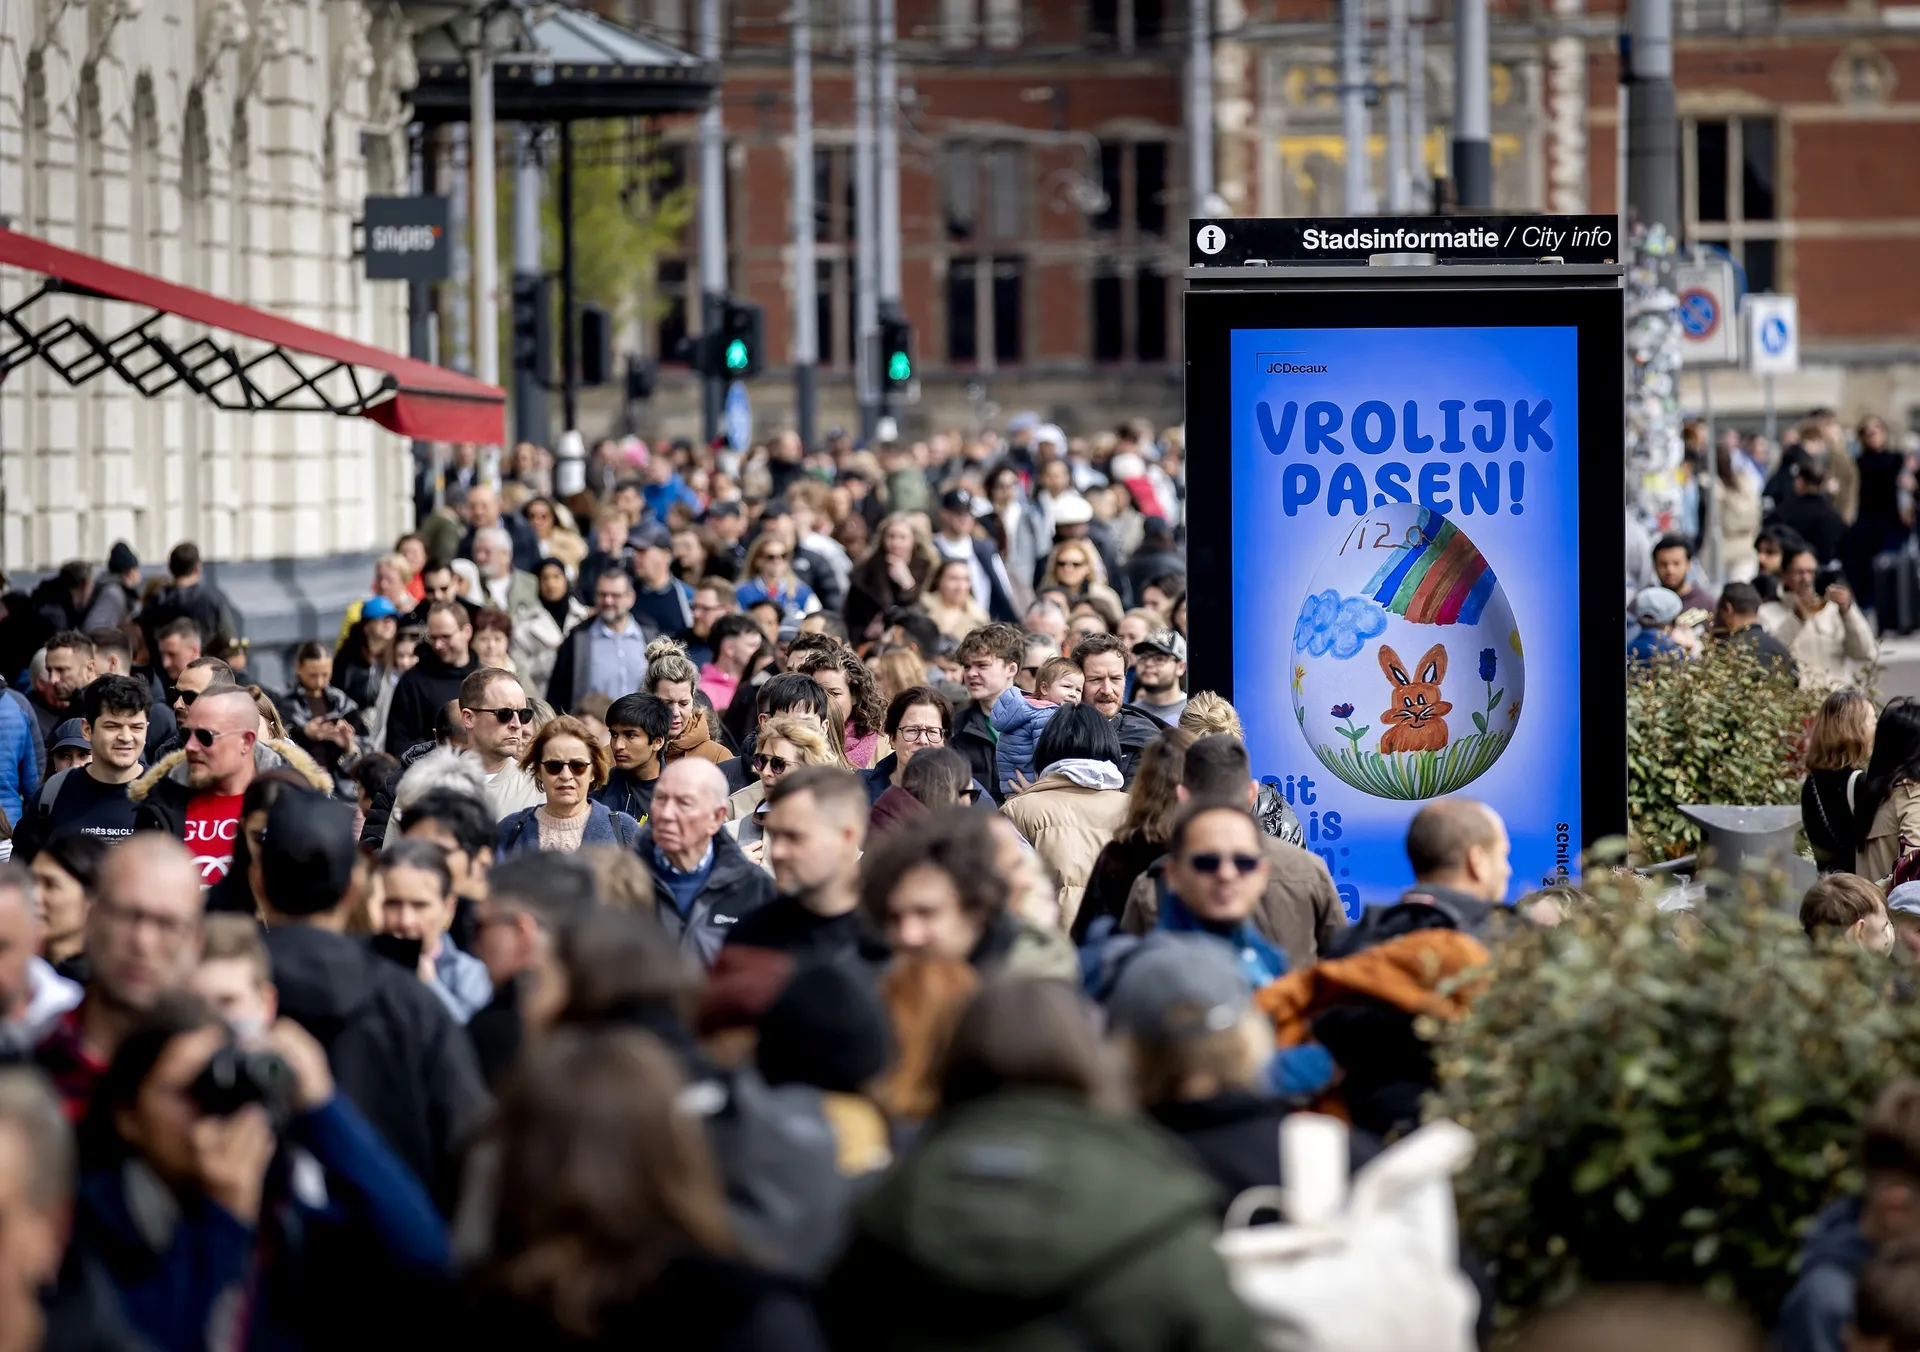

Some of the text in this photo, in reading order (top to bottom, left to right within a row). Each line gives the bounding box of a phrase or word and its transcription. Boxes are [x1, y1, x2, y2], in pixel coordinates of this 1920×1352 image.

[1302, 225, 1612, 252] Stadsinformatie / City info
[1266, 362, 1328, 374] JCDecaux
[1256, 399, 1553, 455] VROLIJK
[1282, 461, 1525, 517] PASEN!
[107, 828, 119, 836] SKI
[1309, 811, 1343, 842] is
